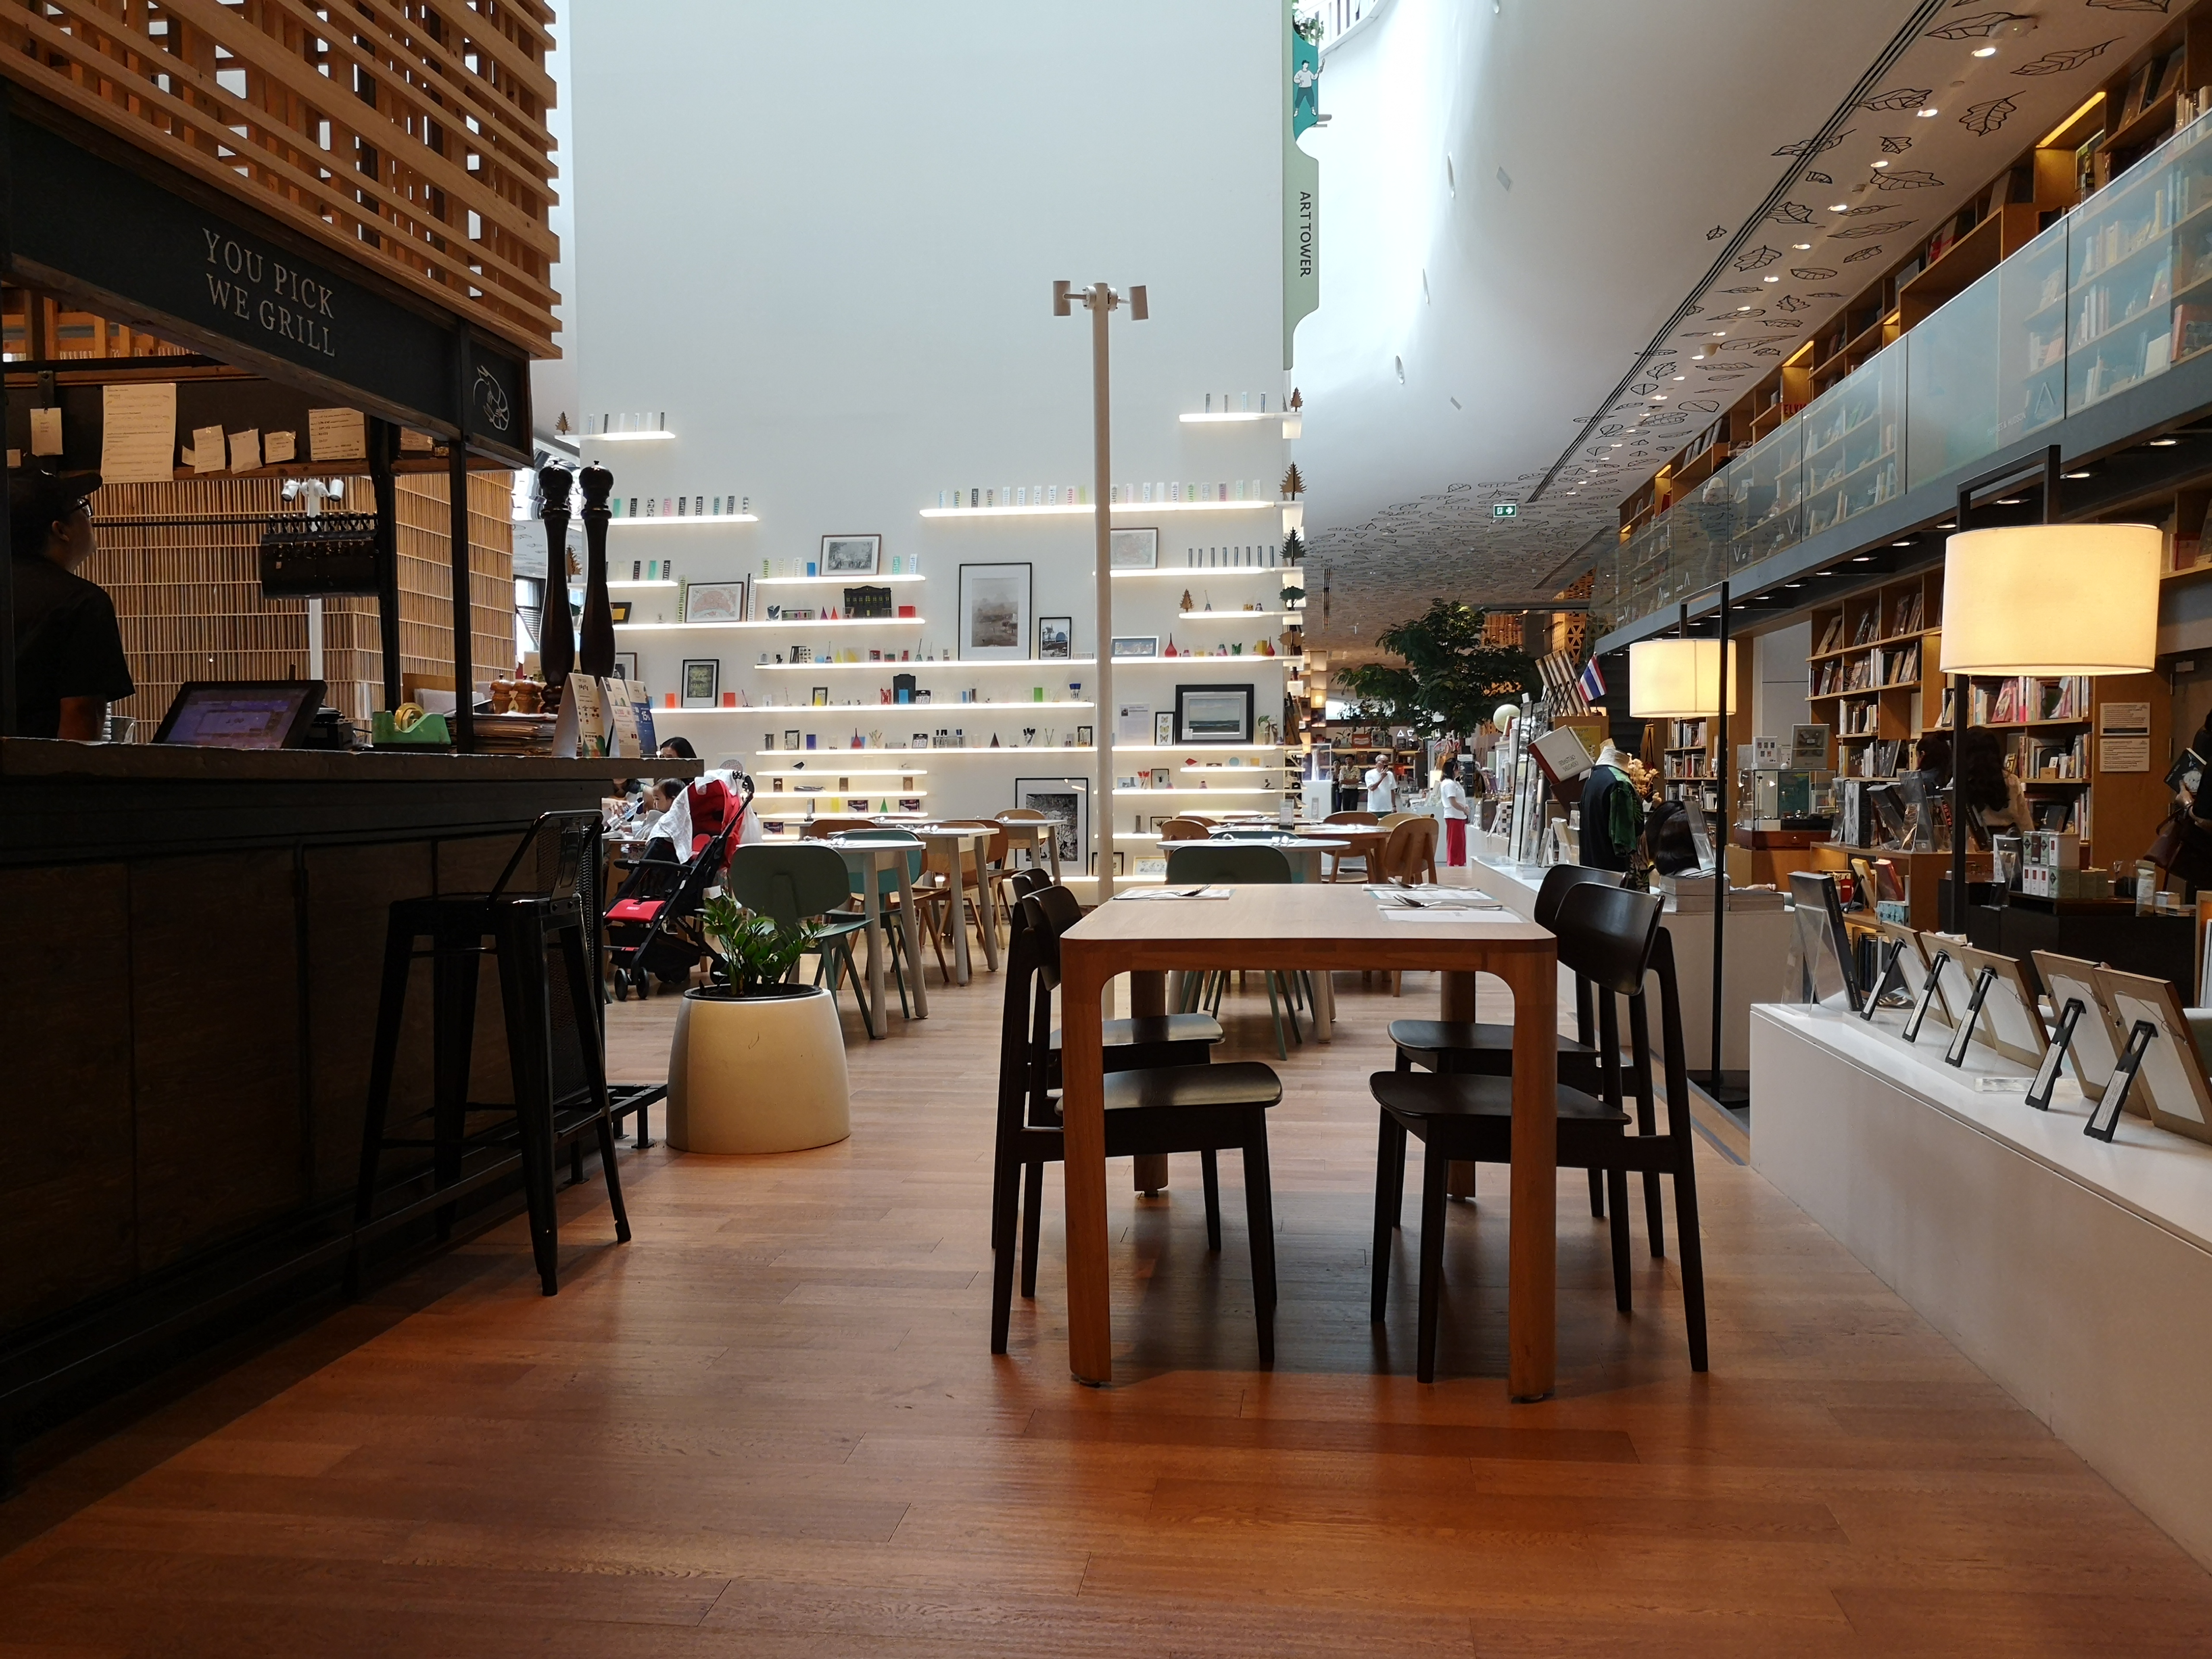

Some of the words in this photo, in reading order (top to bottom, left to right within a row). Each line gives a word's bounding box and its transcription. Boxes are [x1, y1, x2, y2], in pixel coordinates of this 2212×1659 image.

[1300, 191, 1311, 220] ART
[202, 228, 263, 283] YOU
[273, 263, 334, 319] PICK
[1300, 223, 1311, 277] TOWER
[206, 273, 249, 320] WE
[260, 300, 335, 357] GRILL
[1784, 403, 1808, 414] ELVI
